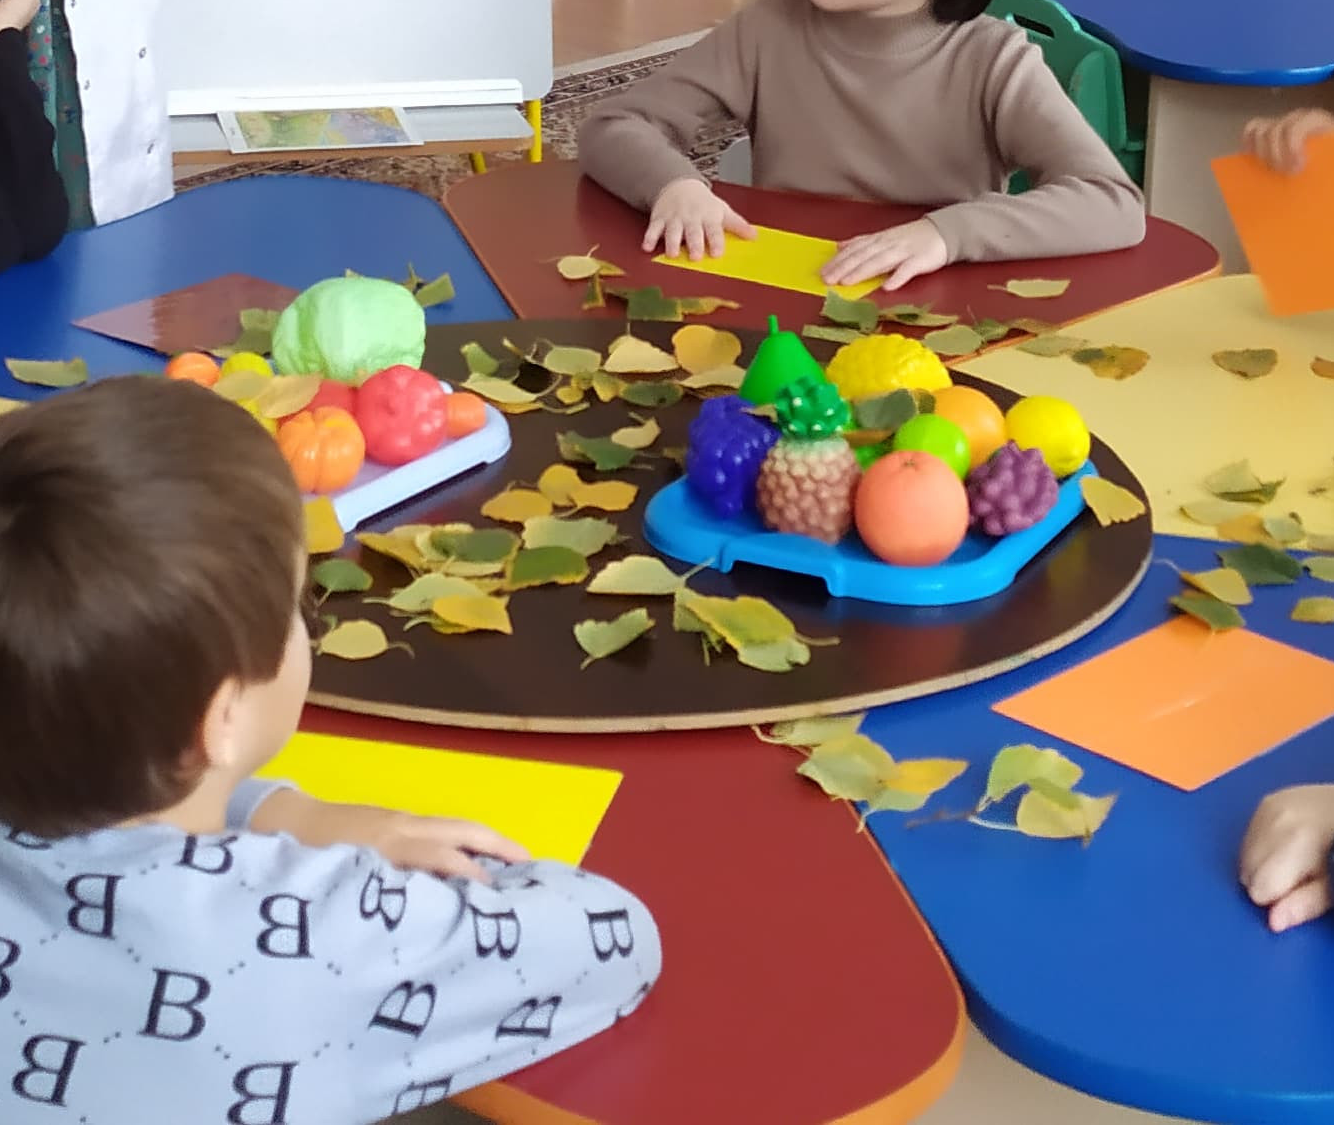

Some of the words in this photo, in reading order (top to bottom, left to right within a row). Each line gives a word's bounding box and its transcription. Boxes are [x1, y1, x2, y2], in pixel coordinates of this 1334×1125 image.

[65, 873, 124, 940] B
[256, 893, 315, 960] B
[467, 902, 522, 960] B
[584, 907, 634, 962] B
[137, 968, 211, 1042] B
[368, 979, 437, 1040] B
[496, 994, 563, 1042] B
[11, 1034, 88, 1108] B
[227, 1061, 299, 1125] B
